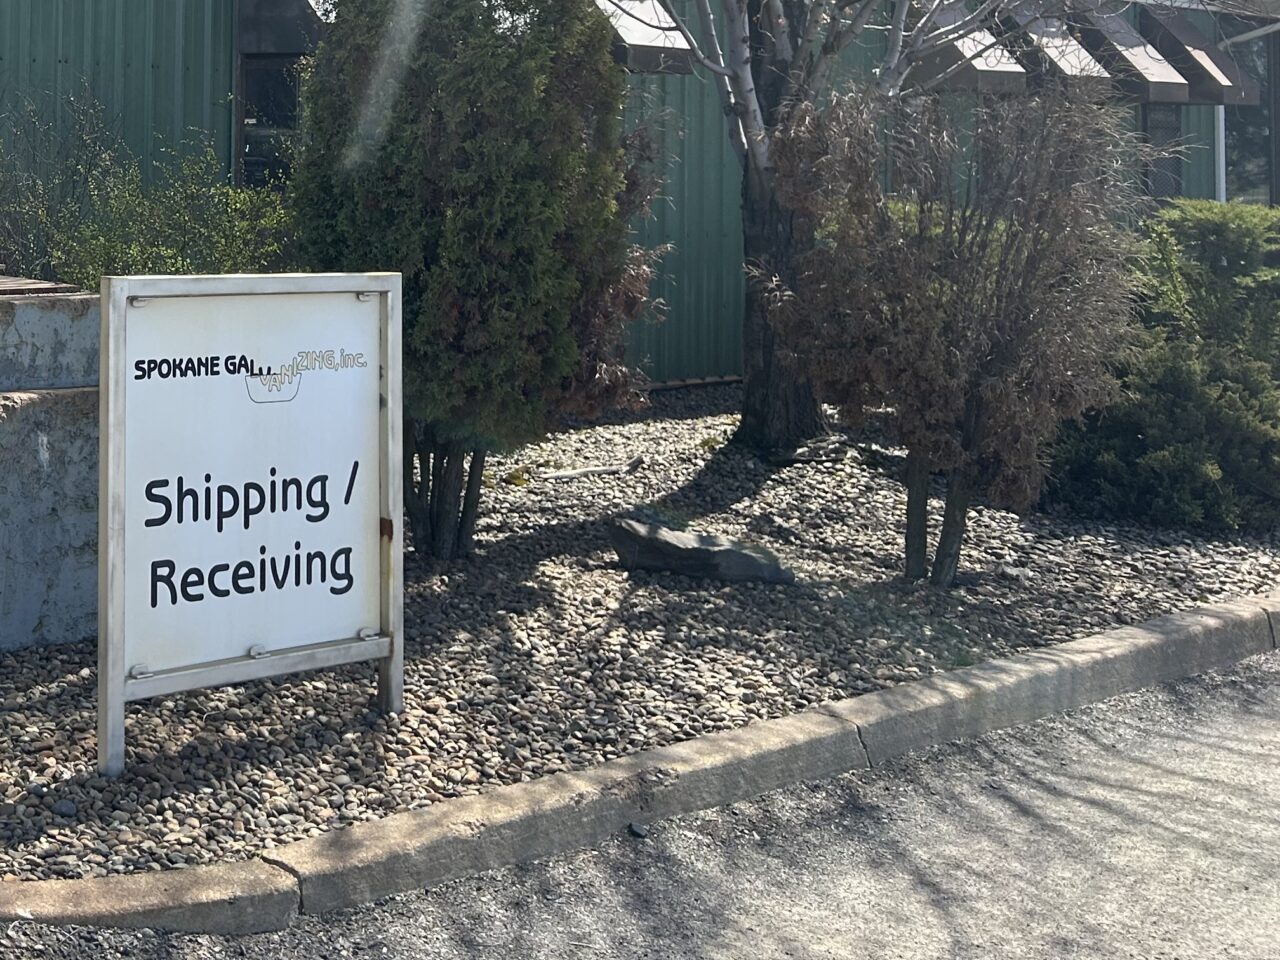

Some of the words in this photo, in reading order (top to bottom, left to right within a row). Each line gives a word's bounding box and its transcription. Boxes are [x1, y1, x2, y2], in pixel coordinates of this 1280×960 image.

[134, 355, 221, 380] SPOKANE
[144, 466, 330, 533] Shipping
[344, 460, 359, 505] /
[150, 541, 354, 608] Receiving
